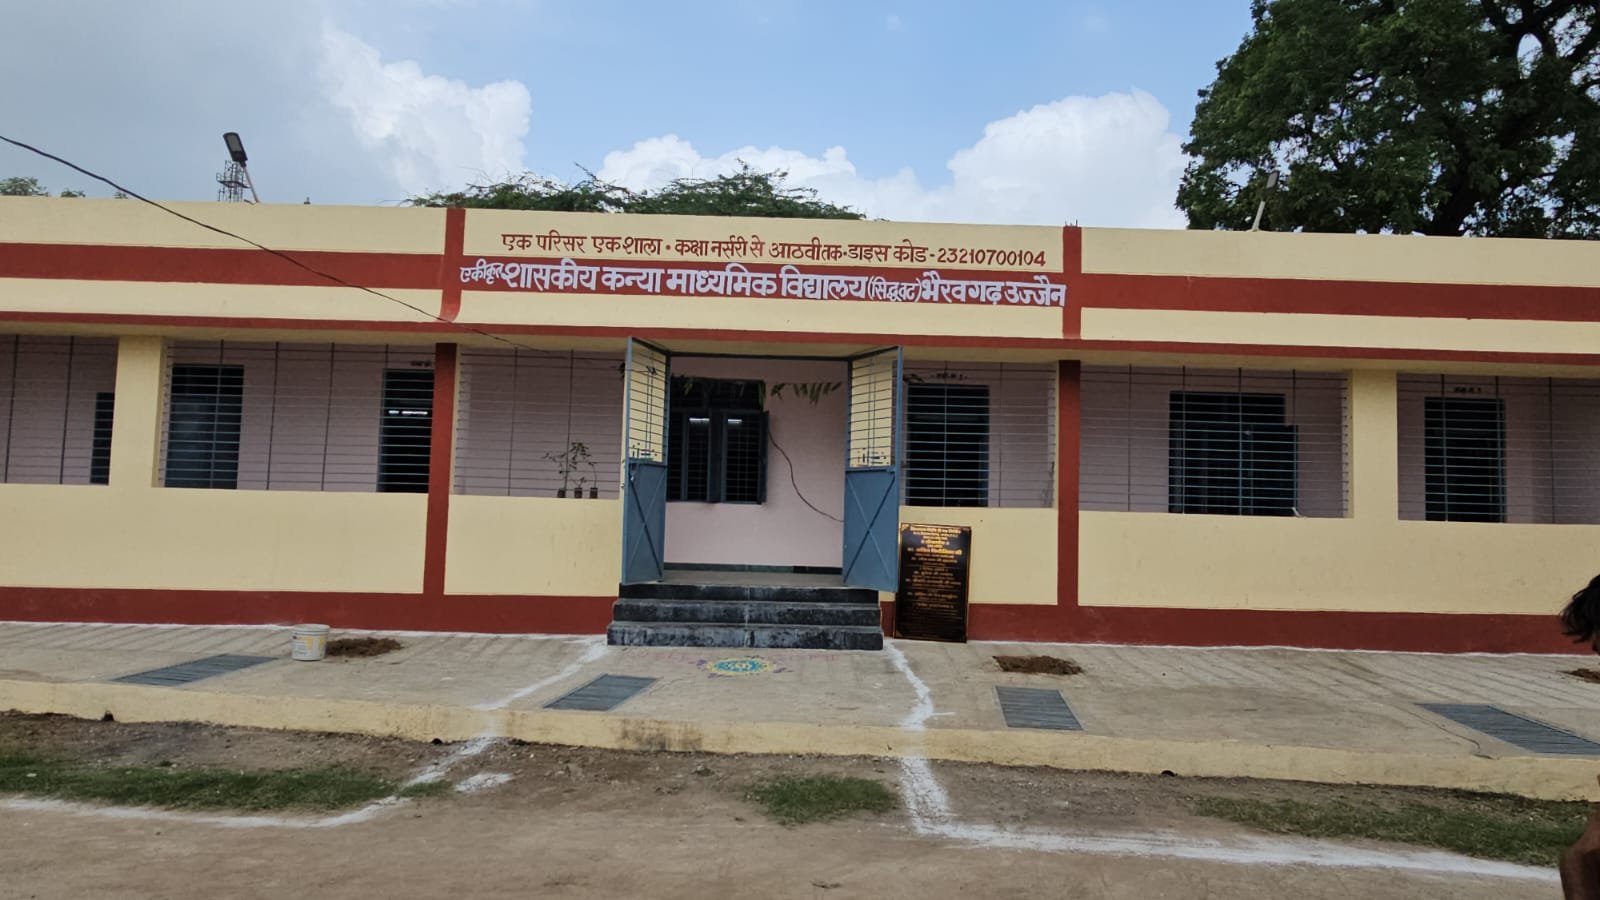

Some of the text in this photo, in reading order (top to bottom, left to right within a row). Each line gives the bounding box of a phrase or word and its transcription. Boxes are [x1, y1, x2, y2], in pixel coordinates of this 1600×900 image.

[501, 233, 532, 251] एक
[536, 230, 587, 252] परिसर
[675, 239, 709, 256] कक्षा
[712, 235, 748, 259] नर्सरी
[750, 235, 765, 258] से
[501, 258, 601, 292] शासकीय
[601, 266, 665, 293] कन्या
[666, 262, 778, 297] माध्यमिक
[780, 264, 869, 300] विद्यालय
[1004, 275, 1066, 307] उज्जैन
